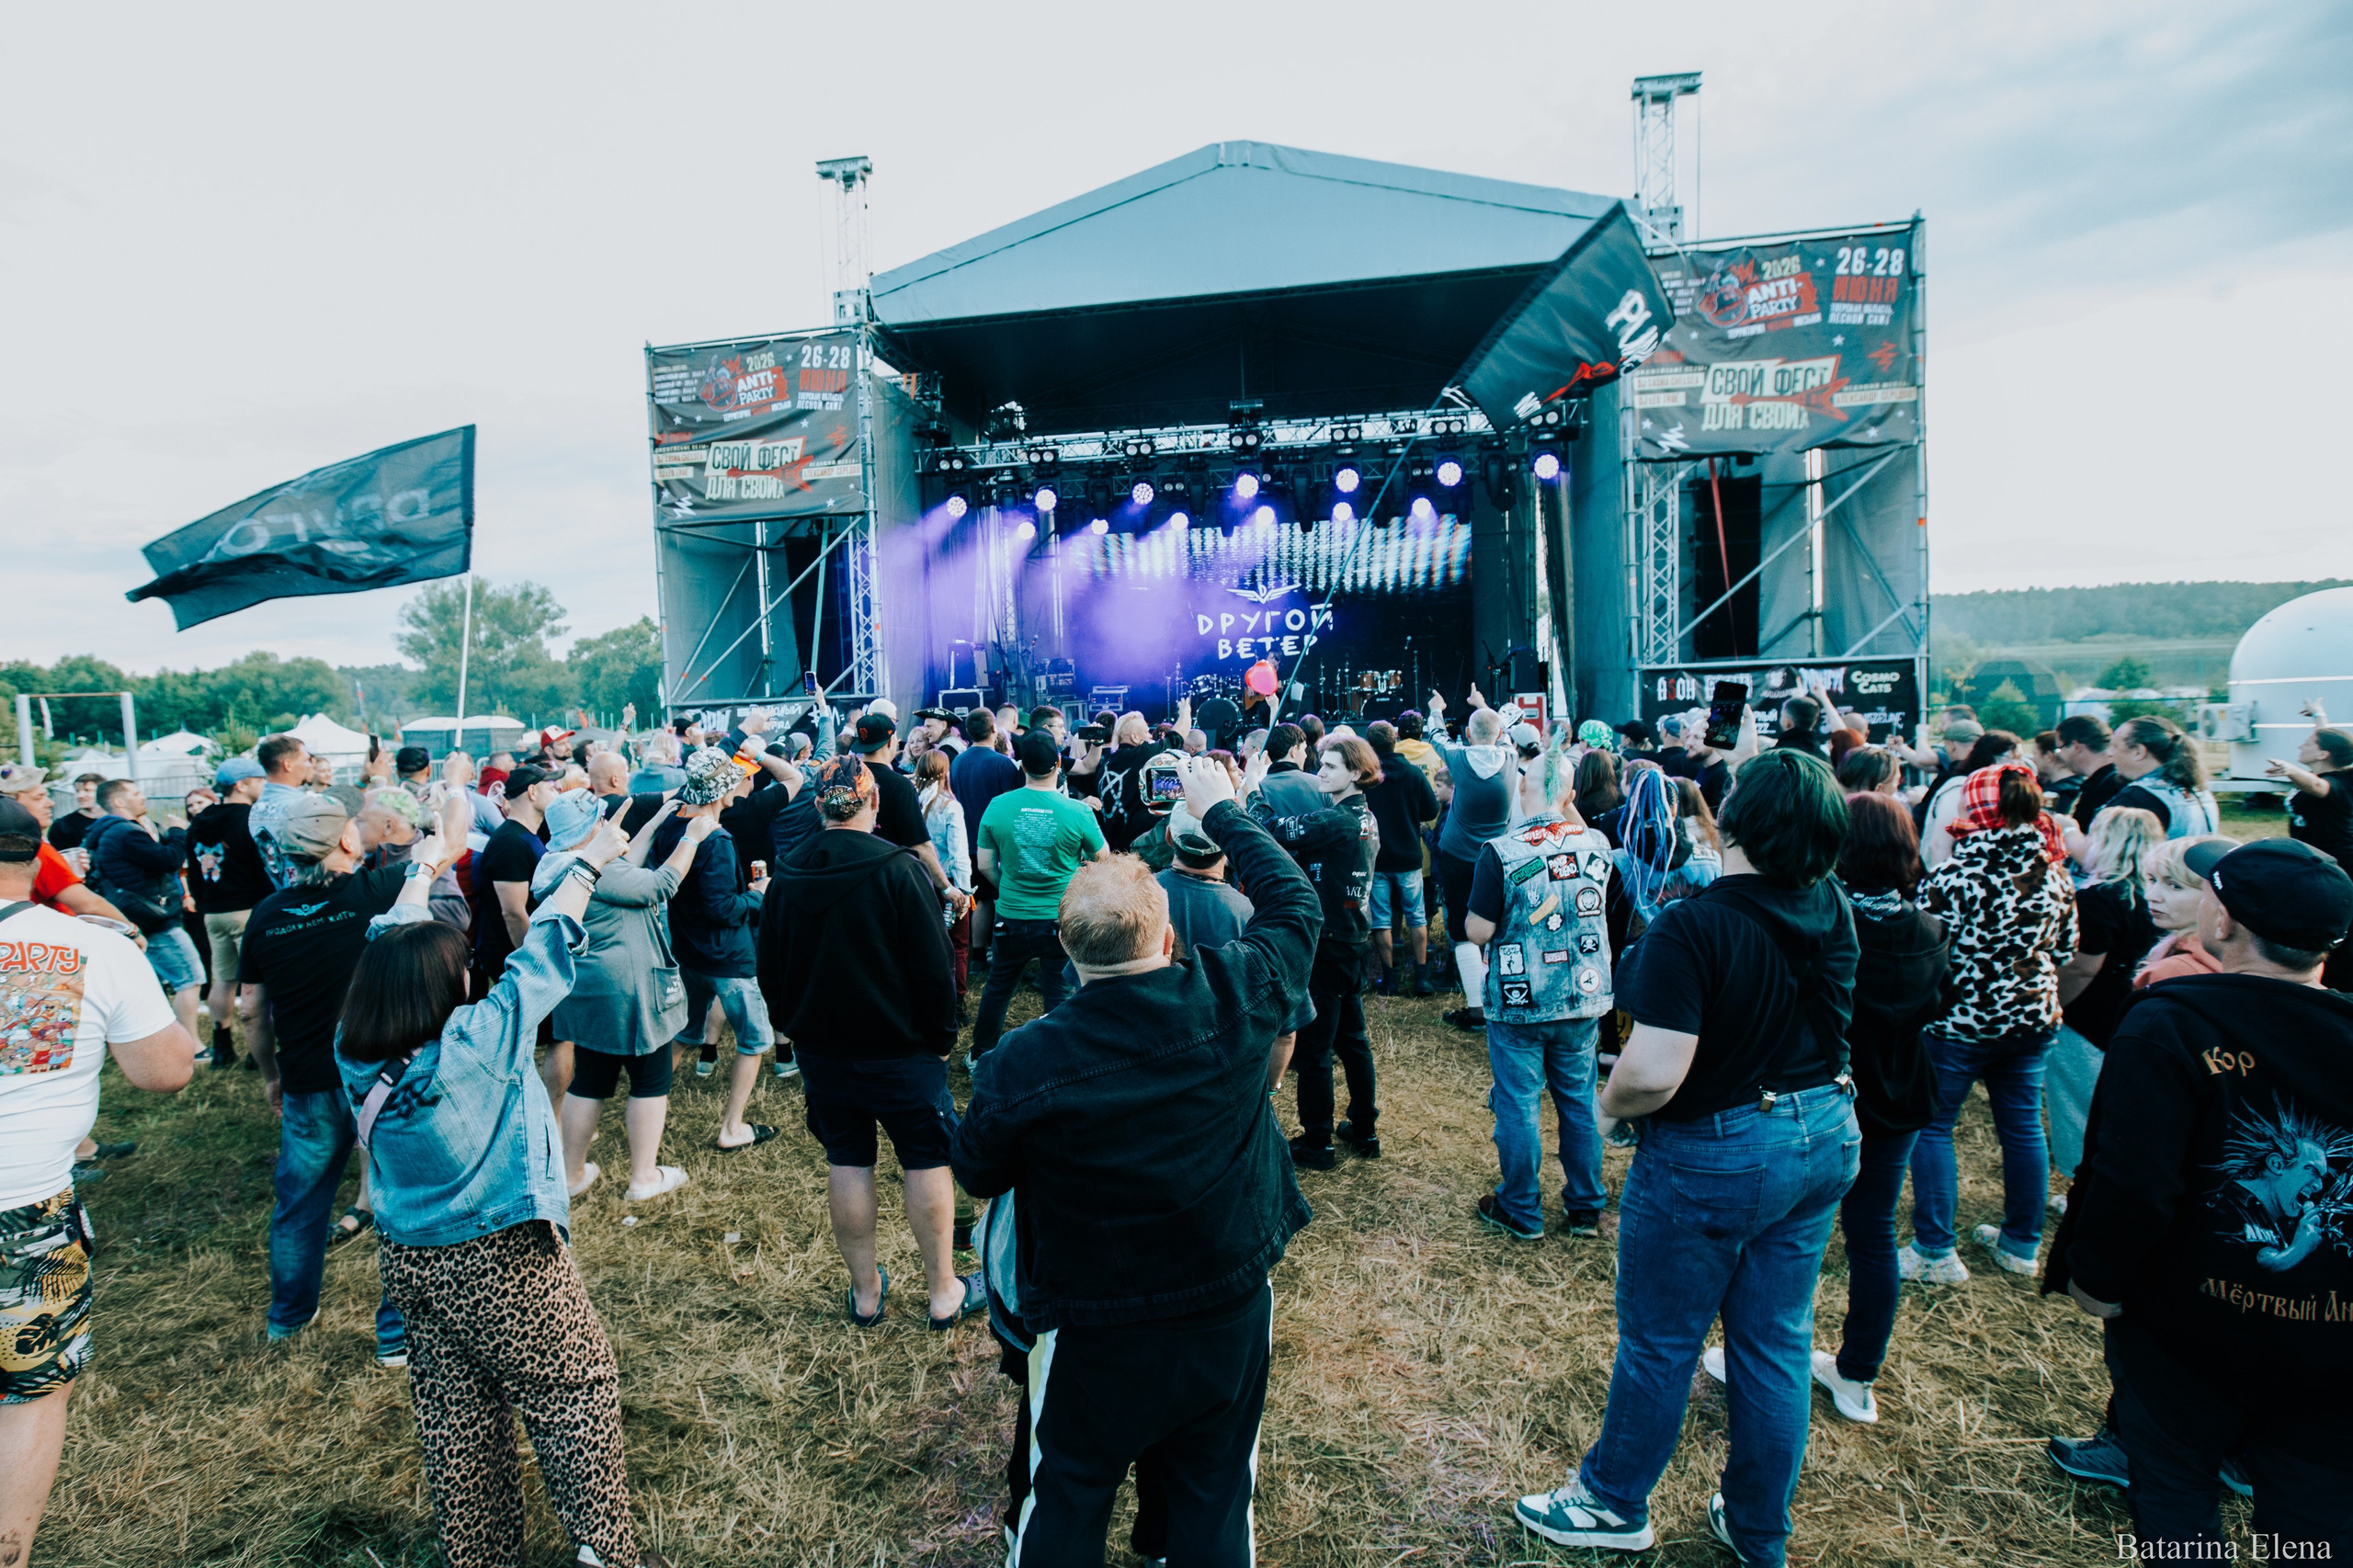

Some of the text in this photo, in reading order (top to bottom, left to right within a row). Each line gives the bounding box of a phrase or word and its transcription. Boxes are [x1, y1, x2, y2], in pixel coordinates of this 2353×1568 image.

[1761, 255, 1802, 280] 2026
[1836, 246, 1904, 276] 26-28
[1748, 278, 1803, 304] ANTI-
[1832, 276, 1899, 303] ИЮНЯ
[1749, 295, 1798, 320] PARTY
[746, 351, 775, 372] 2026
[801, 345, 850, 369] 26-28
[737, 369, 778, 392] ANTI-
[799, 369, 847, 392] ИЮНЯ
[1712, 364, 1828, 396] СВОЙ ФЕСТ
[738, 385, 773, 405] PARTY
[1701, 403, 1810, 431] ДЛЯ СВОИХ
[712, 443, 798, 470] СВОЙ ФЕСТ
[705, 476, 785, 500] ДЛЯ СВОИХ
[1218, 634, 1318, 661] ВЕТЕР
[266, 910, 356, 937] ПРОДОЛЖАЕМ ЖИТЬ
[2200, 1278, 2316, 1322] Мёртвый
